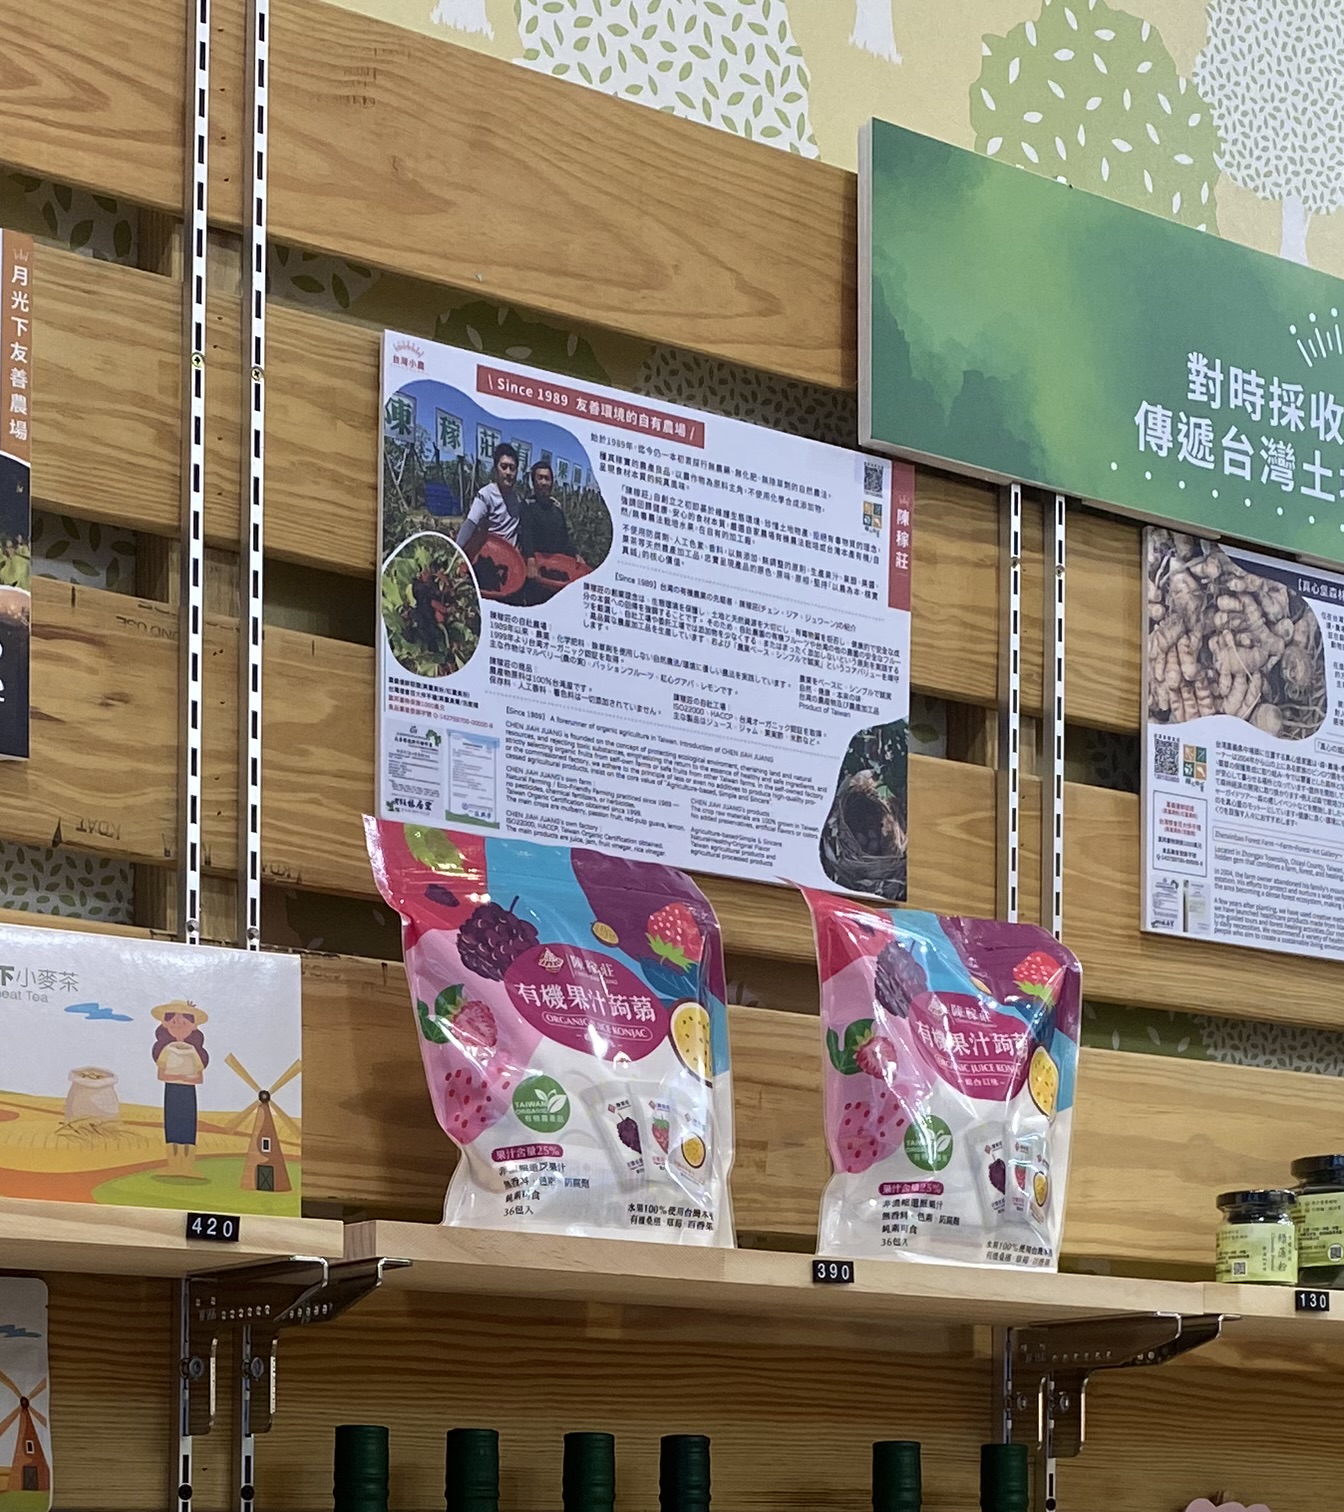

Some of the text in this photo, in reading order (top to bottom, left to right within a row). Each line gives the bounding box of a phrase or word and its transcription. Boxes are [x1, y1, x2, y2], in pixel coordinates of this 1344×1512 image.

[9, 262, 30, 443] 月光下友善農場
[497, 376, 533, 399] Since
[537, 387, 569, 408] 1989
[895, 507, 910, 570] 陳稼莊
[26, 989, 49, 1003] Tea
[518, 982, 657, 1023] 有機果汁蒟蒻
[192, 1217, 233, 1238] 420
[817, 1263, 851, 1279] 390
[1300, 1294, 1327, 1308] 130
